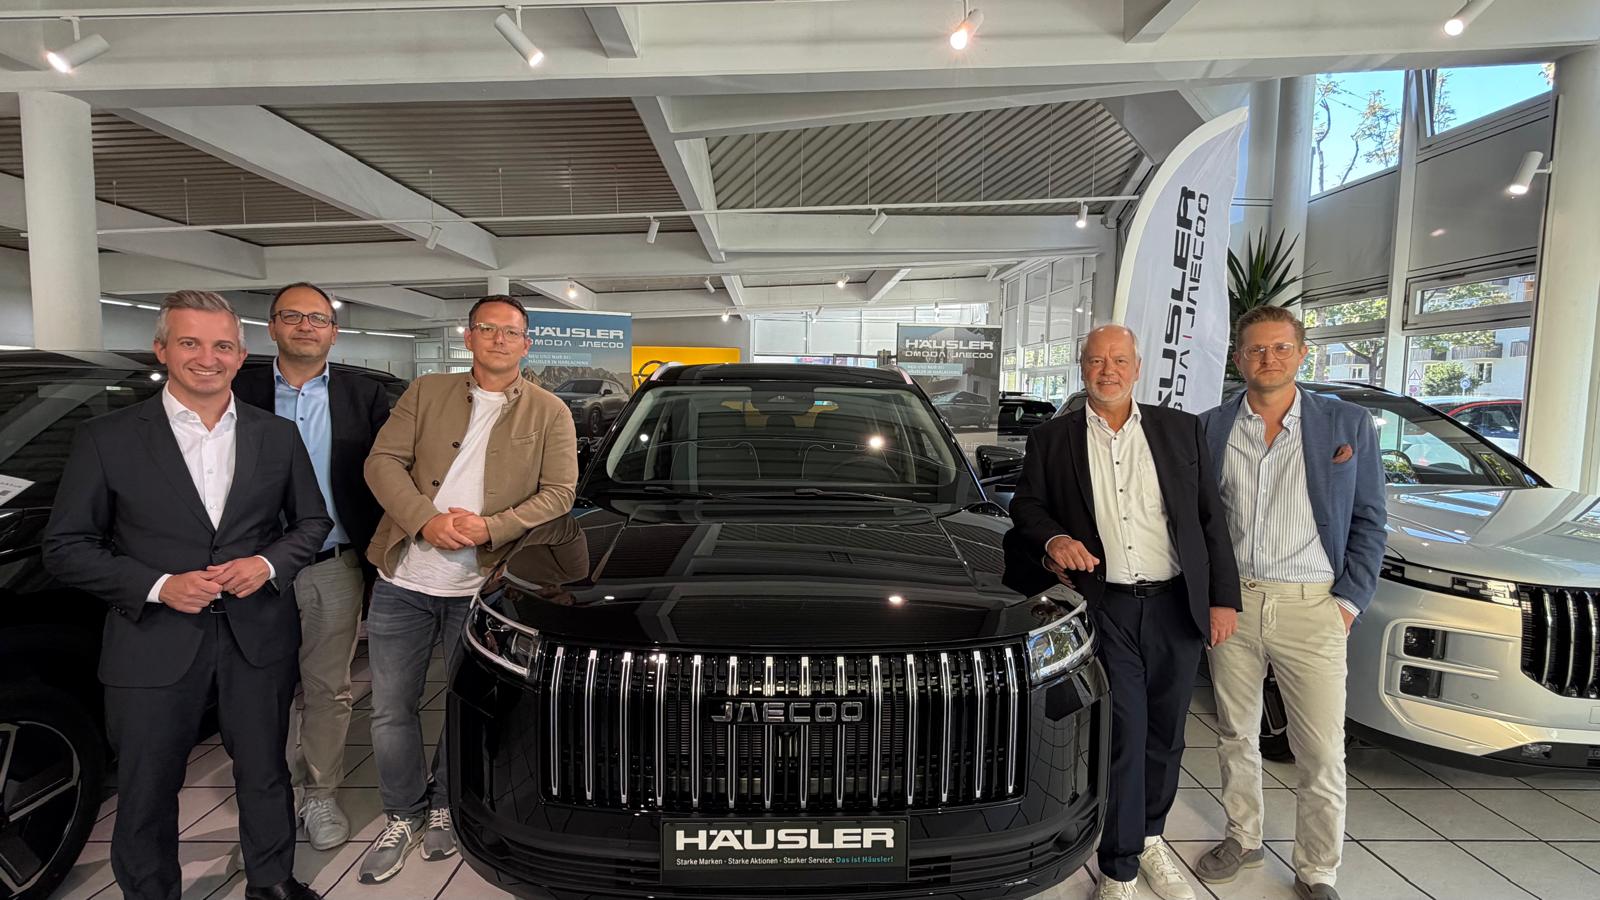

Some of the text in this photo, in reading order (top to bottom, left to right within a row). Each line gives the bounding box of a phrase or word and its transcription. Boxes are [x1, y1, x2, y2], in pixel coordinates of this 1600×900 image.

[1186, 193, 1209, 329] JAECOO
[527, 326, 624, 340] HÄUSLER
[578, 341, 624, 349] JAECOO
[905, 339, 994, 350] HÄUSLER
[905, 350, 994, 359] OMODA JAECOO
[710, 701, 863, 723] JAECOO
[675, 827, 895, 851] HÄUSLER
[676, 855, 894, 866] Starke Marken Starke Aktionen Starker Service: Das ist Häusler!
